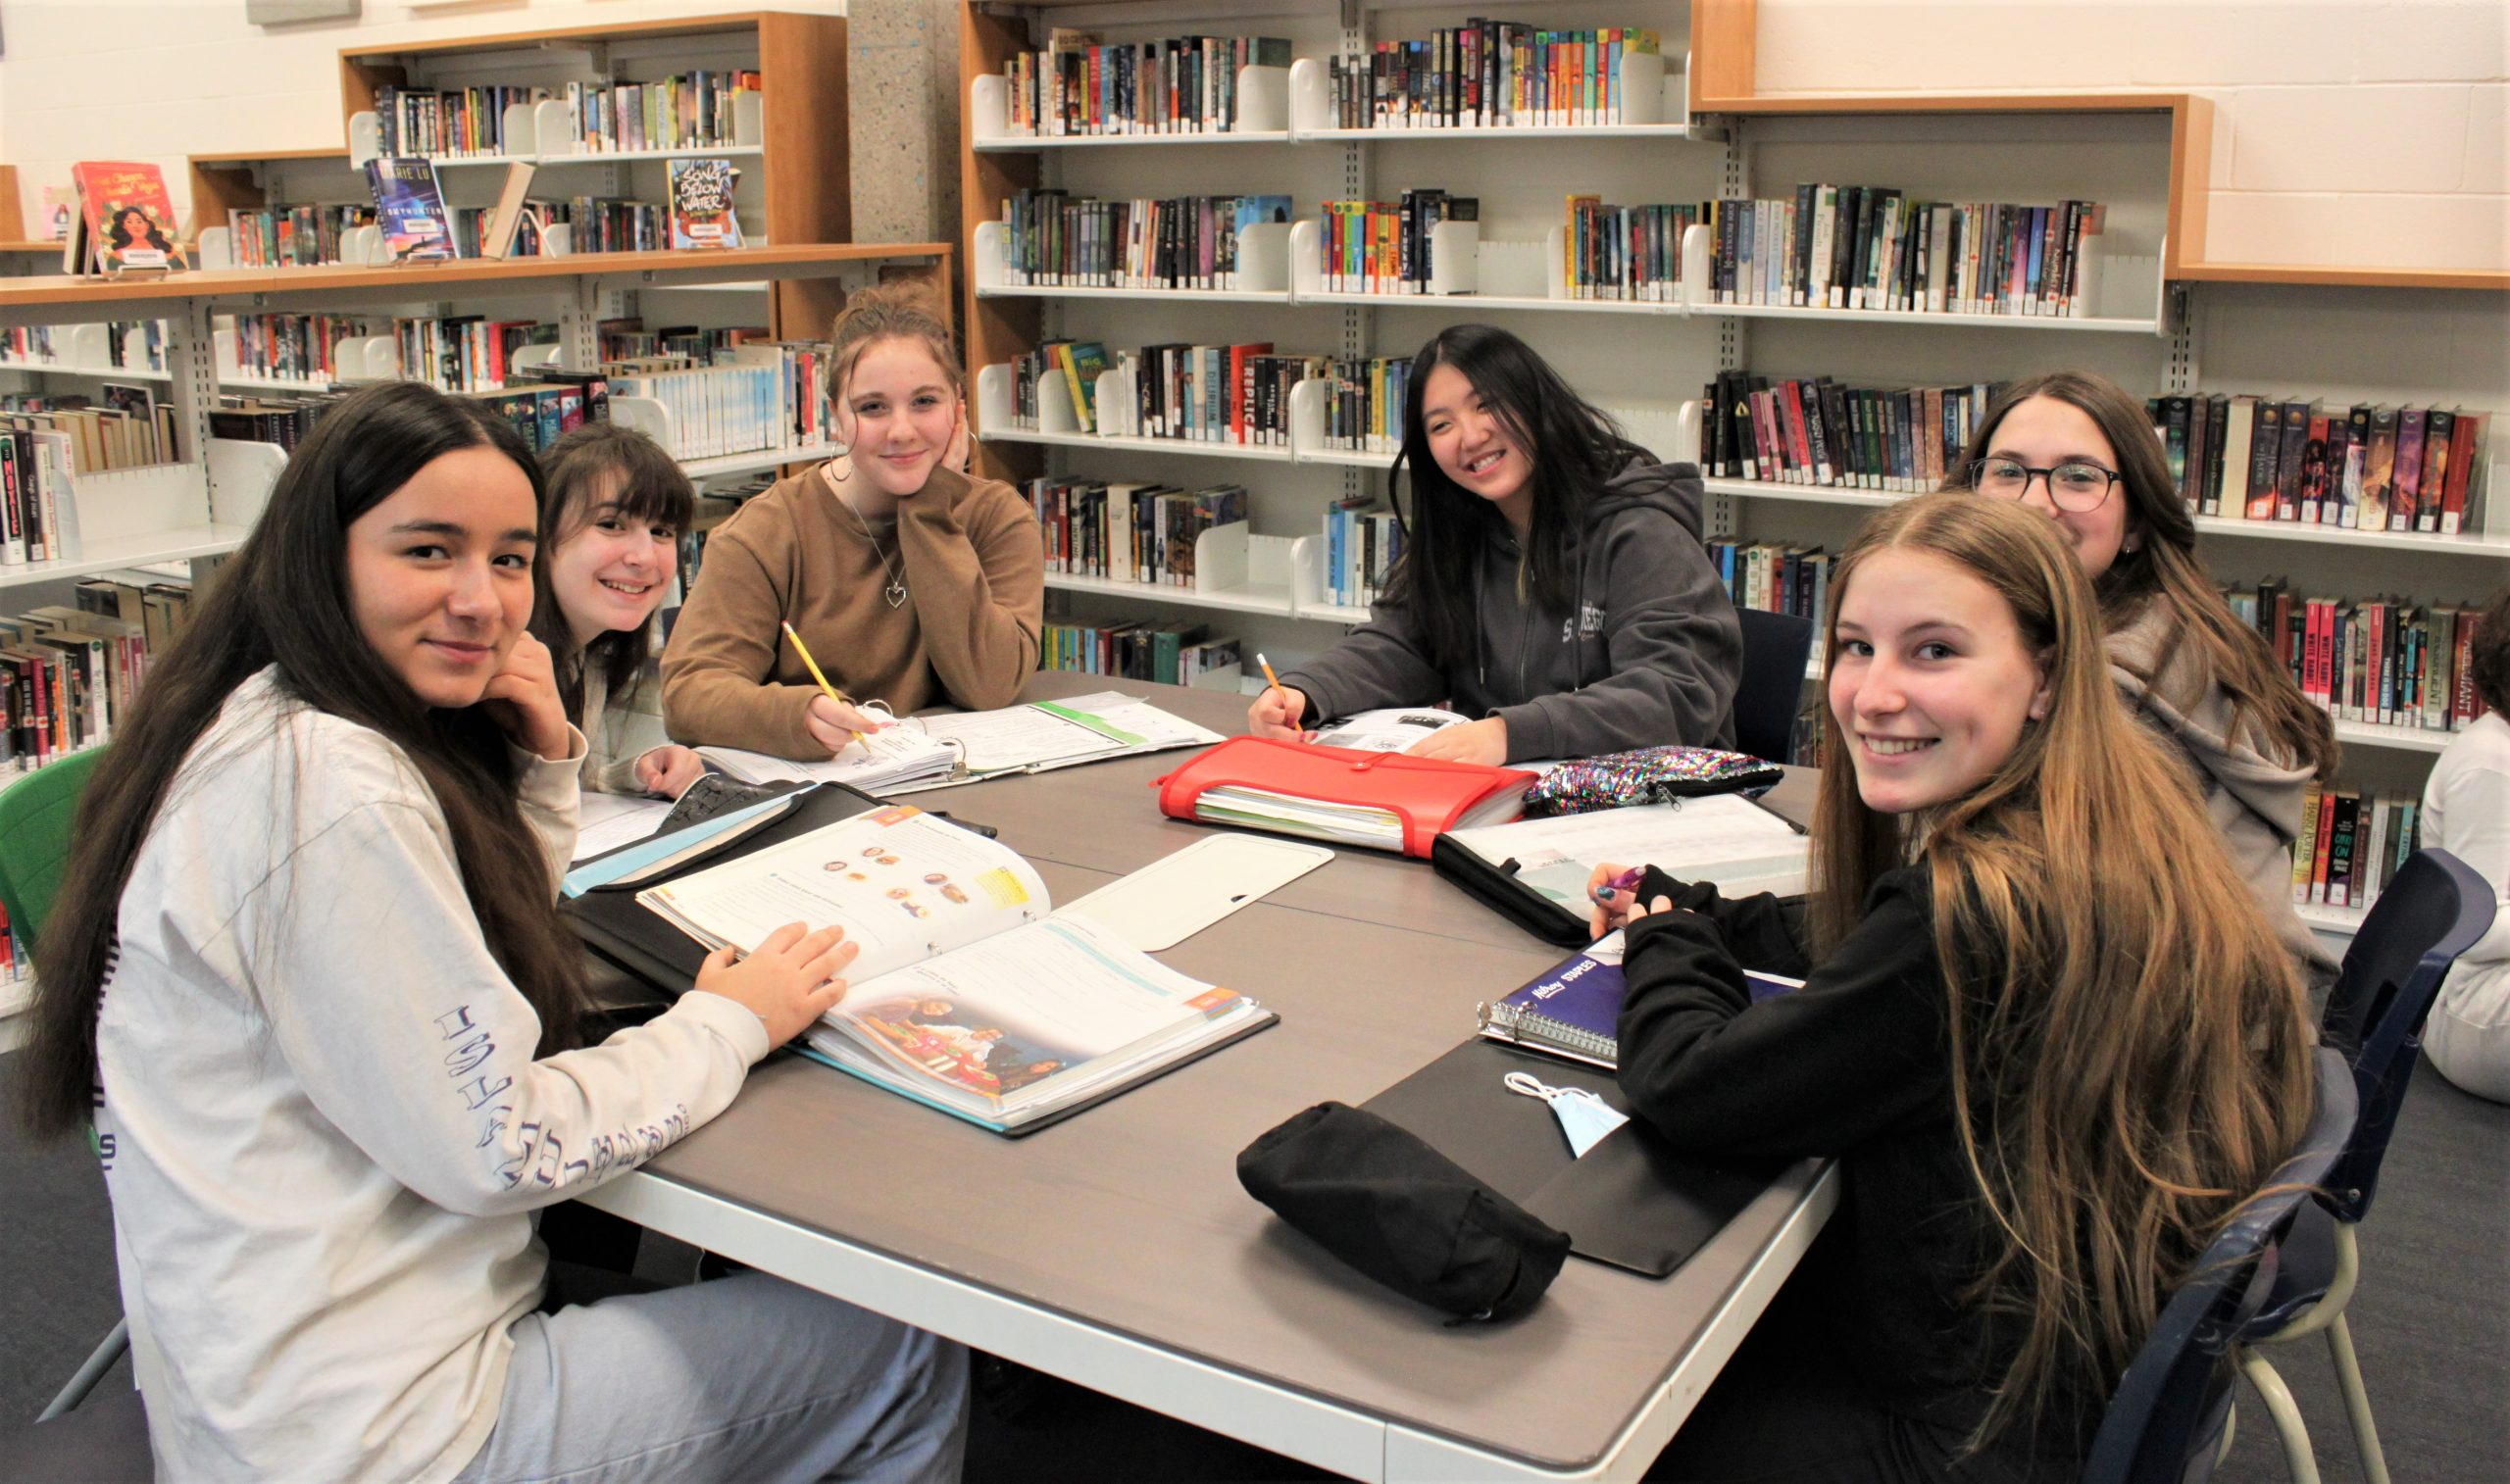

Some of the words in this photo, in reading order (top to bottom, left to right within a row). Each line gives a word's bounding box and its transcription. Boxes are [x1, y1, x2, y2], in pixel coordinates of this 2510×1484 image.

[417, 167, 429, 180] LU
[682, 165, 722, 182] SONG
[680, 176, 726, 197] BELOW
[682, 195, 725, 211] WATER
[1207, 371, 1217, 421] DELIRIUM
[3, 460, 19, 534] MOXIE
[2305, 803, 2317, 829] HARRY
[2302, 832, 2314, 863] POTTER
[1561, 960, 1597, 982] STAPLES
[1531, 981, 1566, 1000] Hilroy
